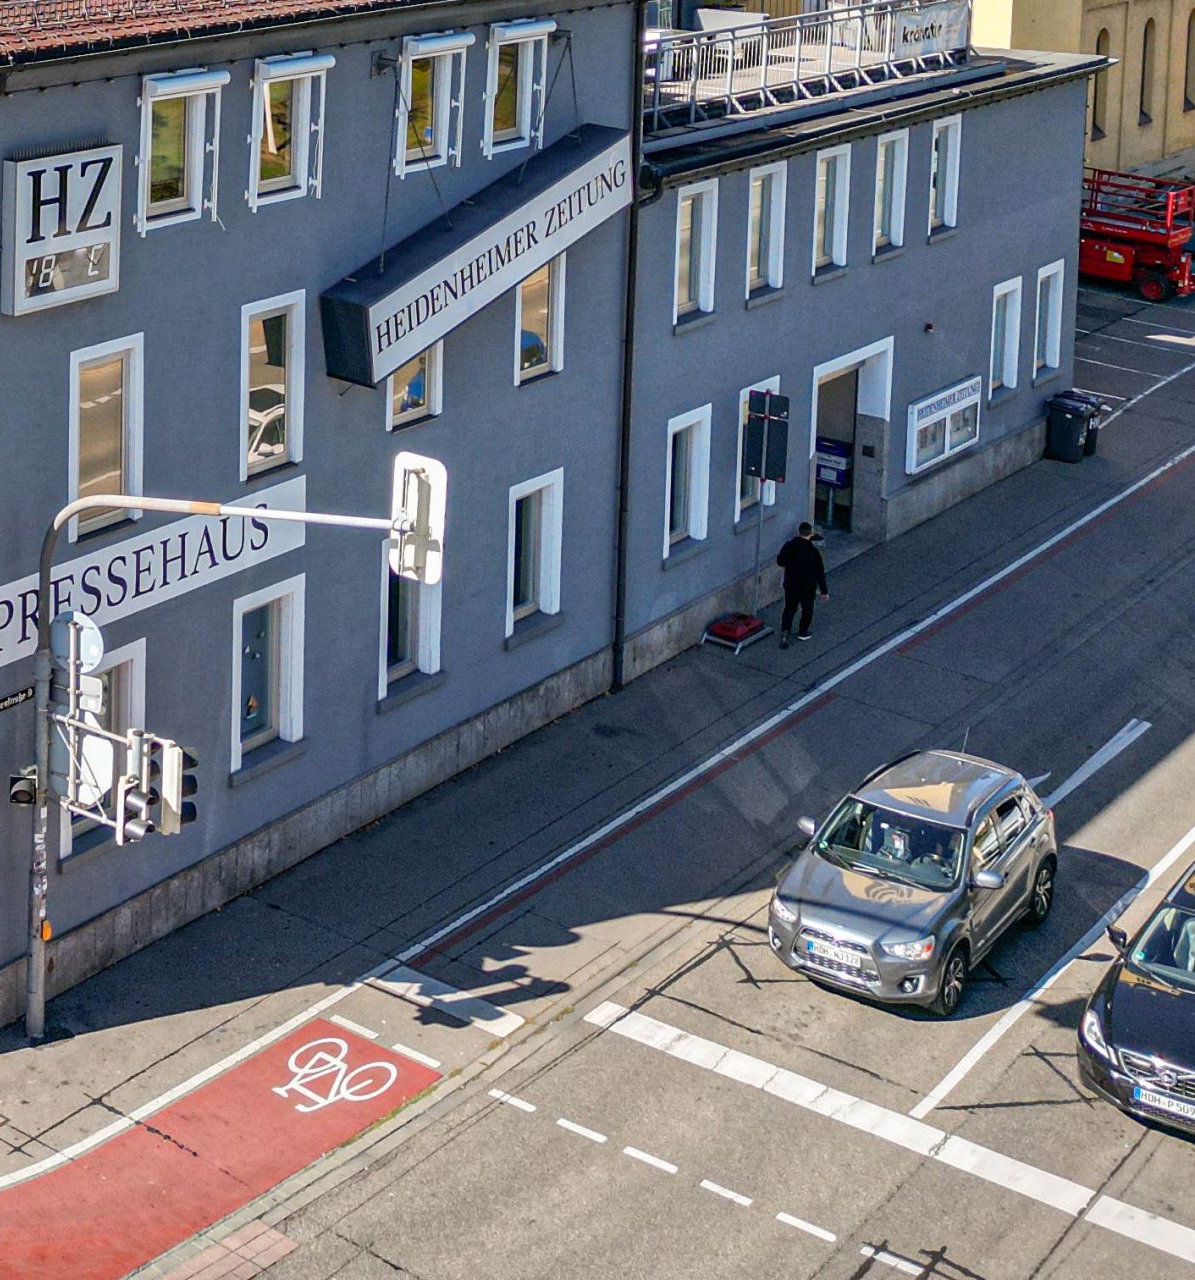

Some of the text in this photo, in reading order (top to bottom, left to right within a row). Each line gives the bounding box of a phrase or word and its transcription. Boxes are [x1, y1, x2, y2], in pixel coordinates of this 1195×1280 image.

[26, 157, 113, 244] HZ
[376, 160, 627, 355] HEIDENHEIMER ZEITUNG
